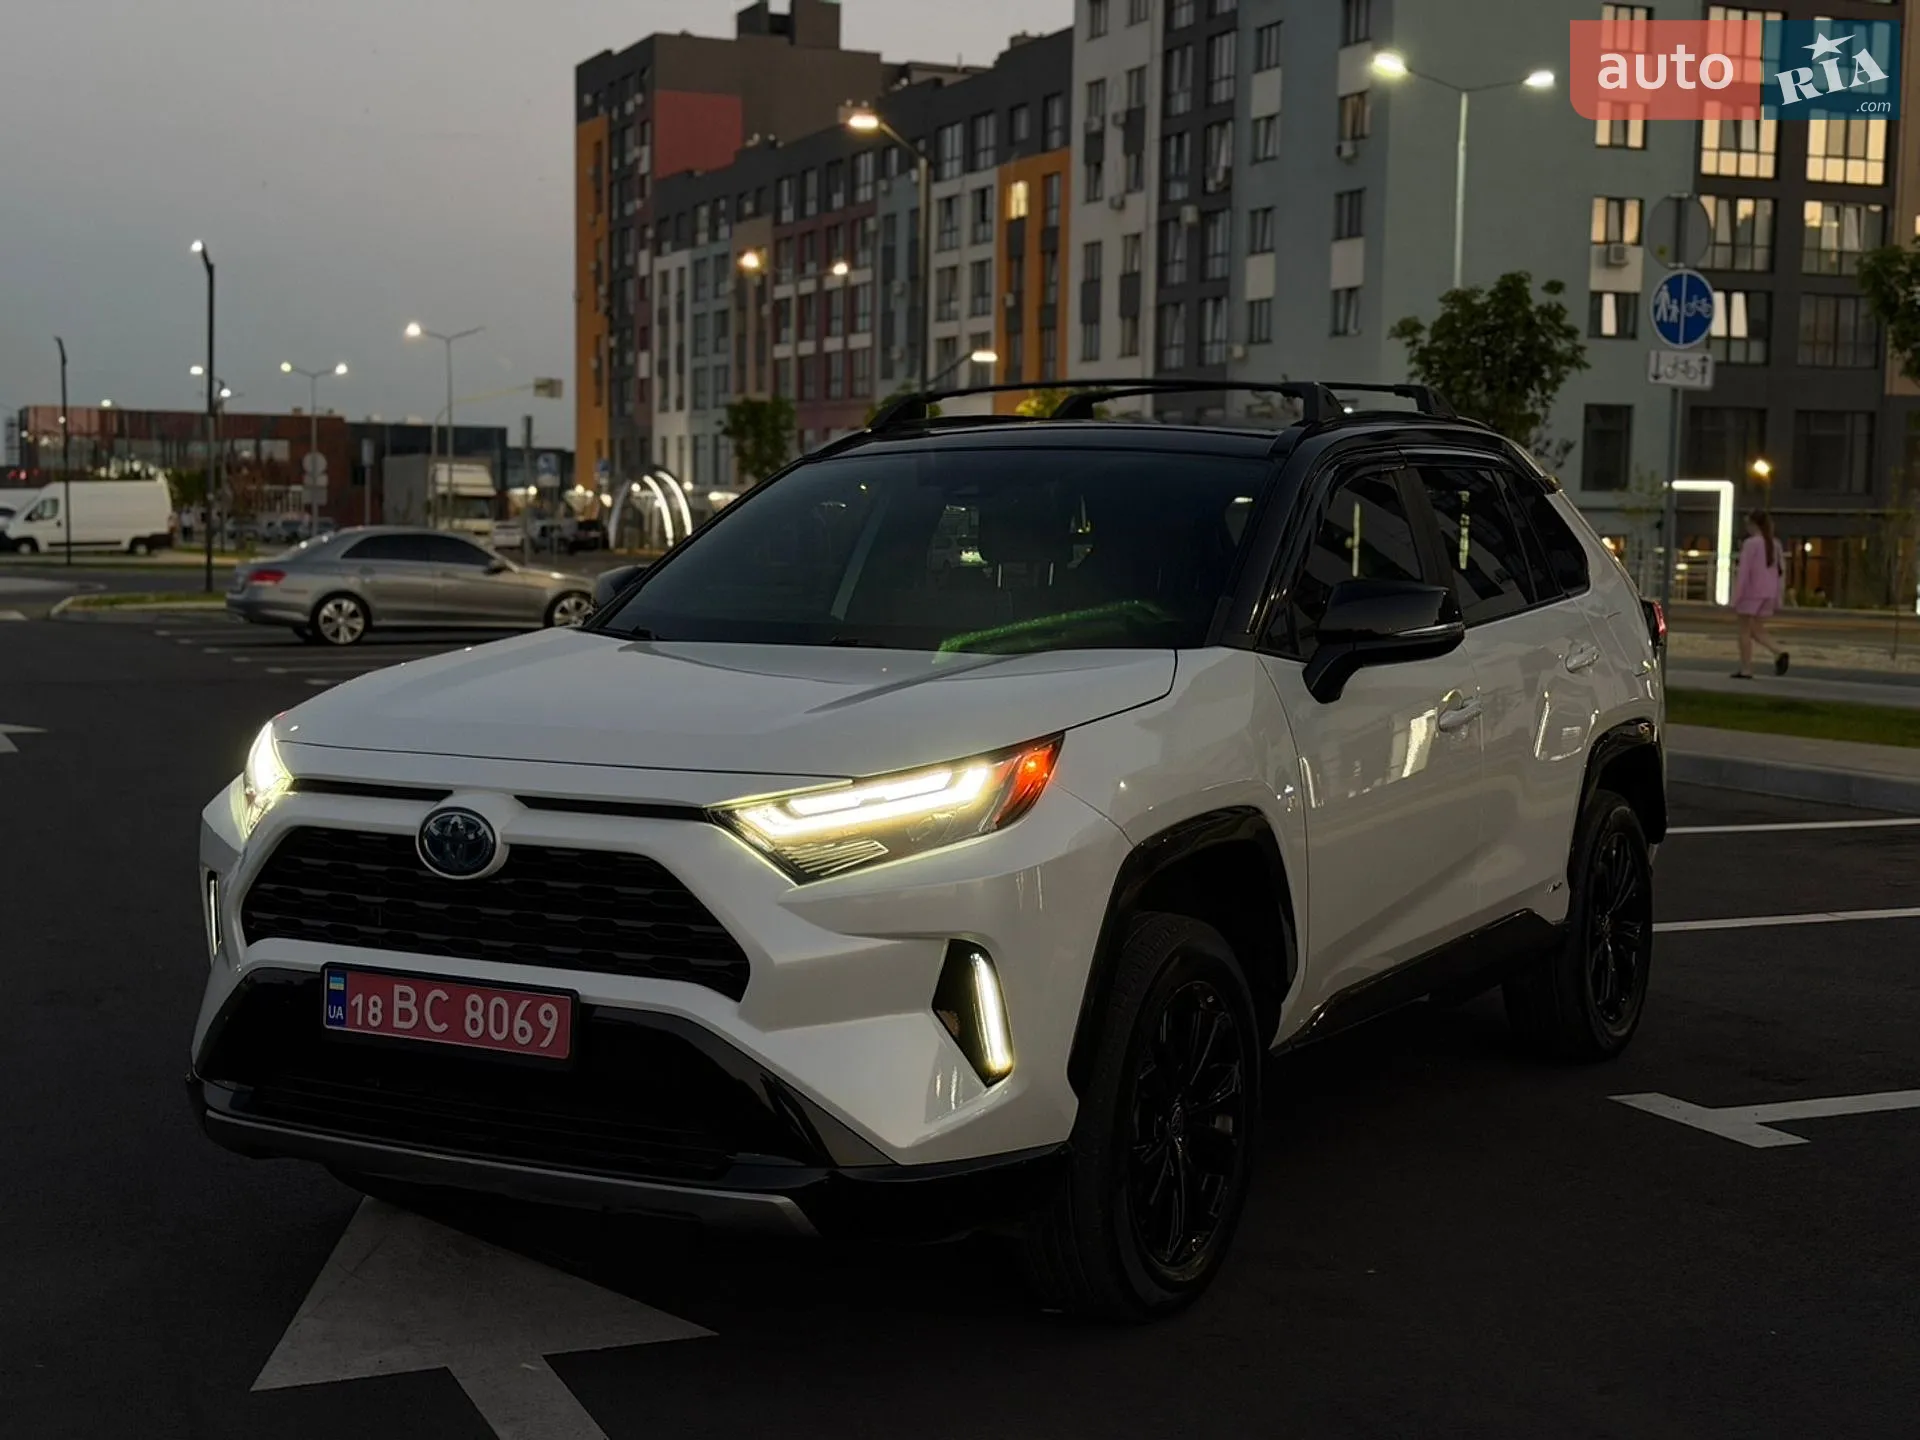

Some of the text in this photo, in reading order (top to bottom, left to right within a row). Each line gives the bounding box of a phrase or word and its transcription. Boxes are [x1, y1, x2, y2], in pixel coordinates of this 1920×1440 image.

[328, 1005, 344, 1020] UA
[350, 984, 559, 1048] 18 BC 8069
